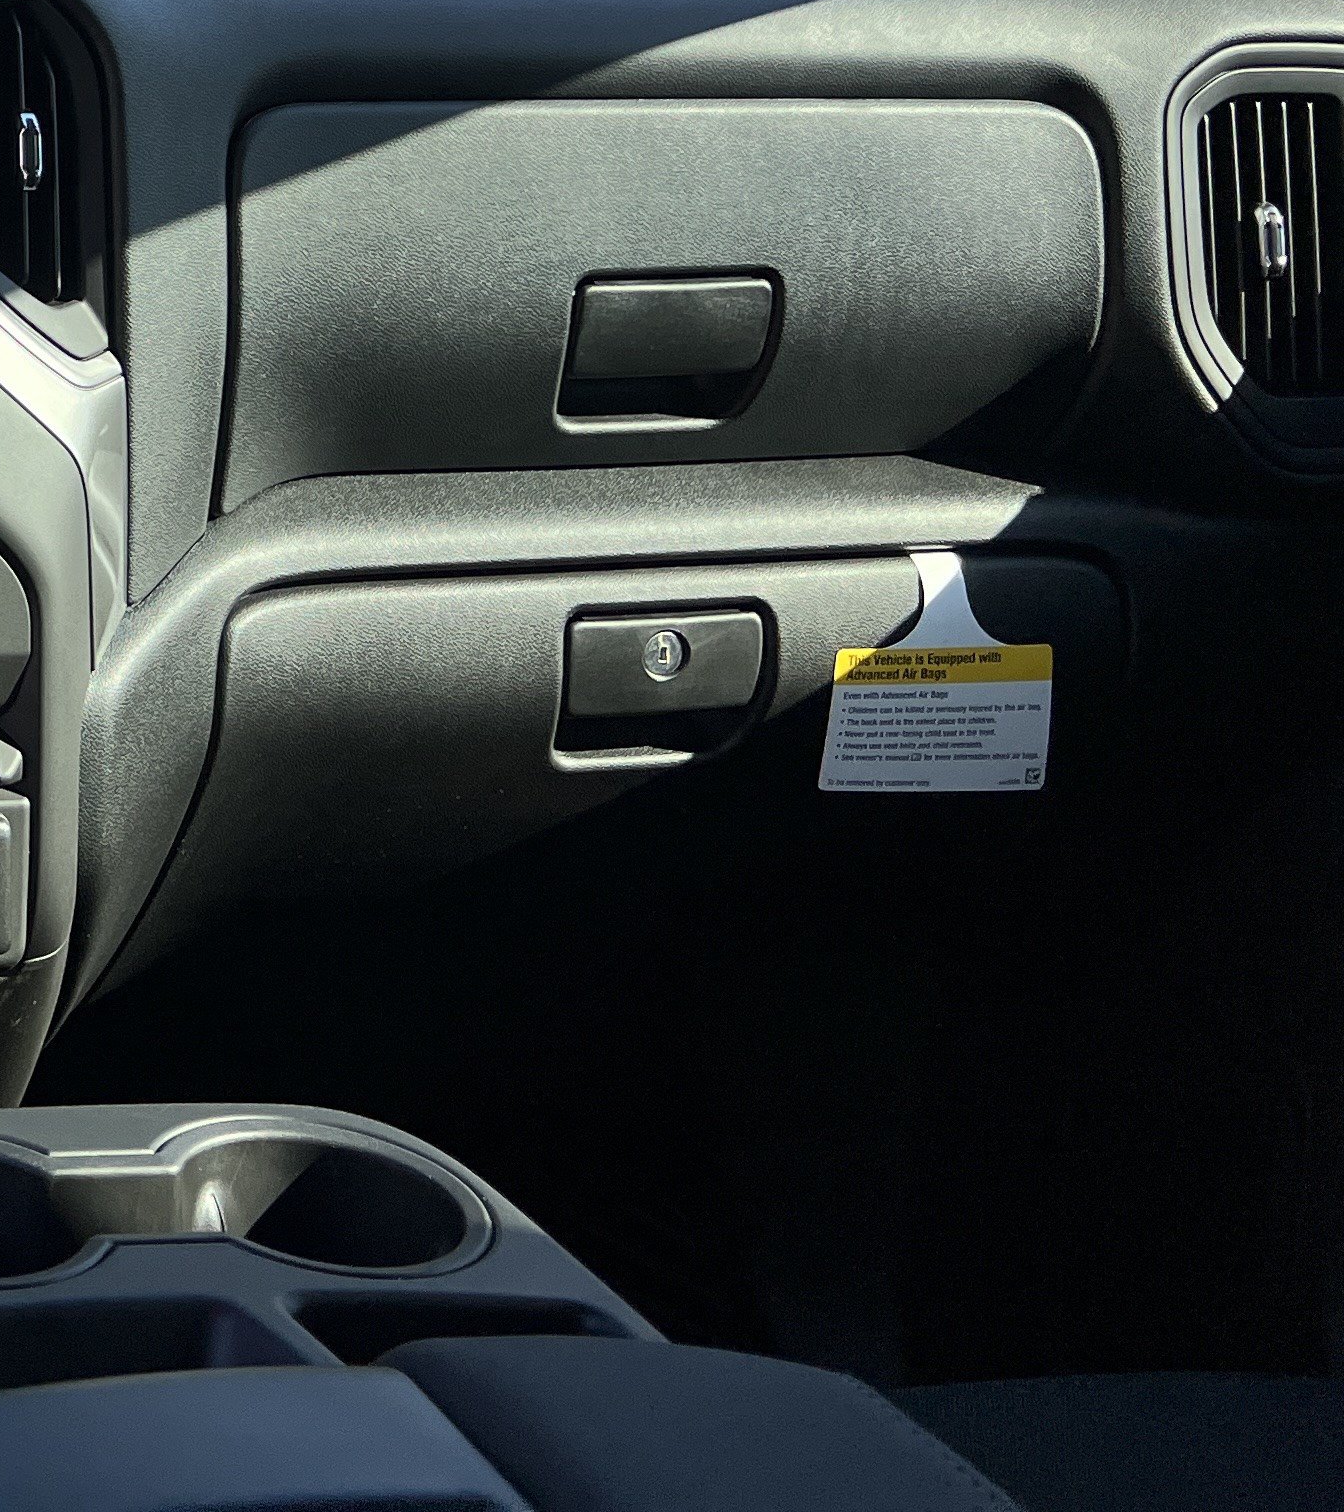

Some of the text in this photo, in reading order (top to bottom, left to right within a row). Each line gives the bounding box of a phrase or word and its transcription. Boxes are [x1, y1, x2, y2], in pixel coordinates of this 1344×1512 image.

[849, 652, 1002, 667] This Vehicle is Equipped with
[846, 668, 947, 681] Advanced Air Bags
[844, 692, 861, 700] Even
[931, 691, 949, 699] Bags
